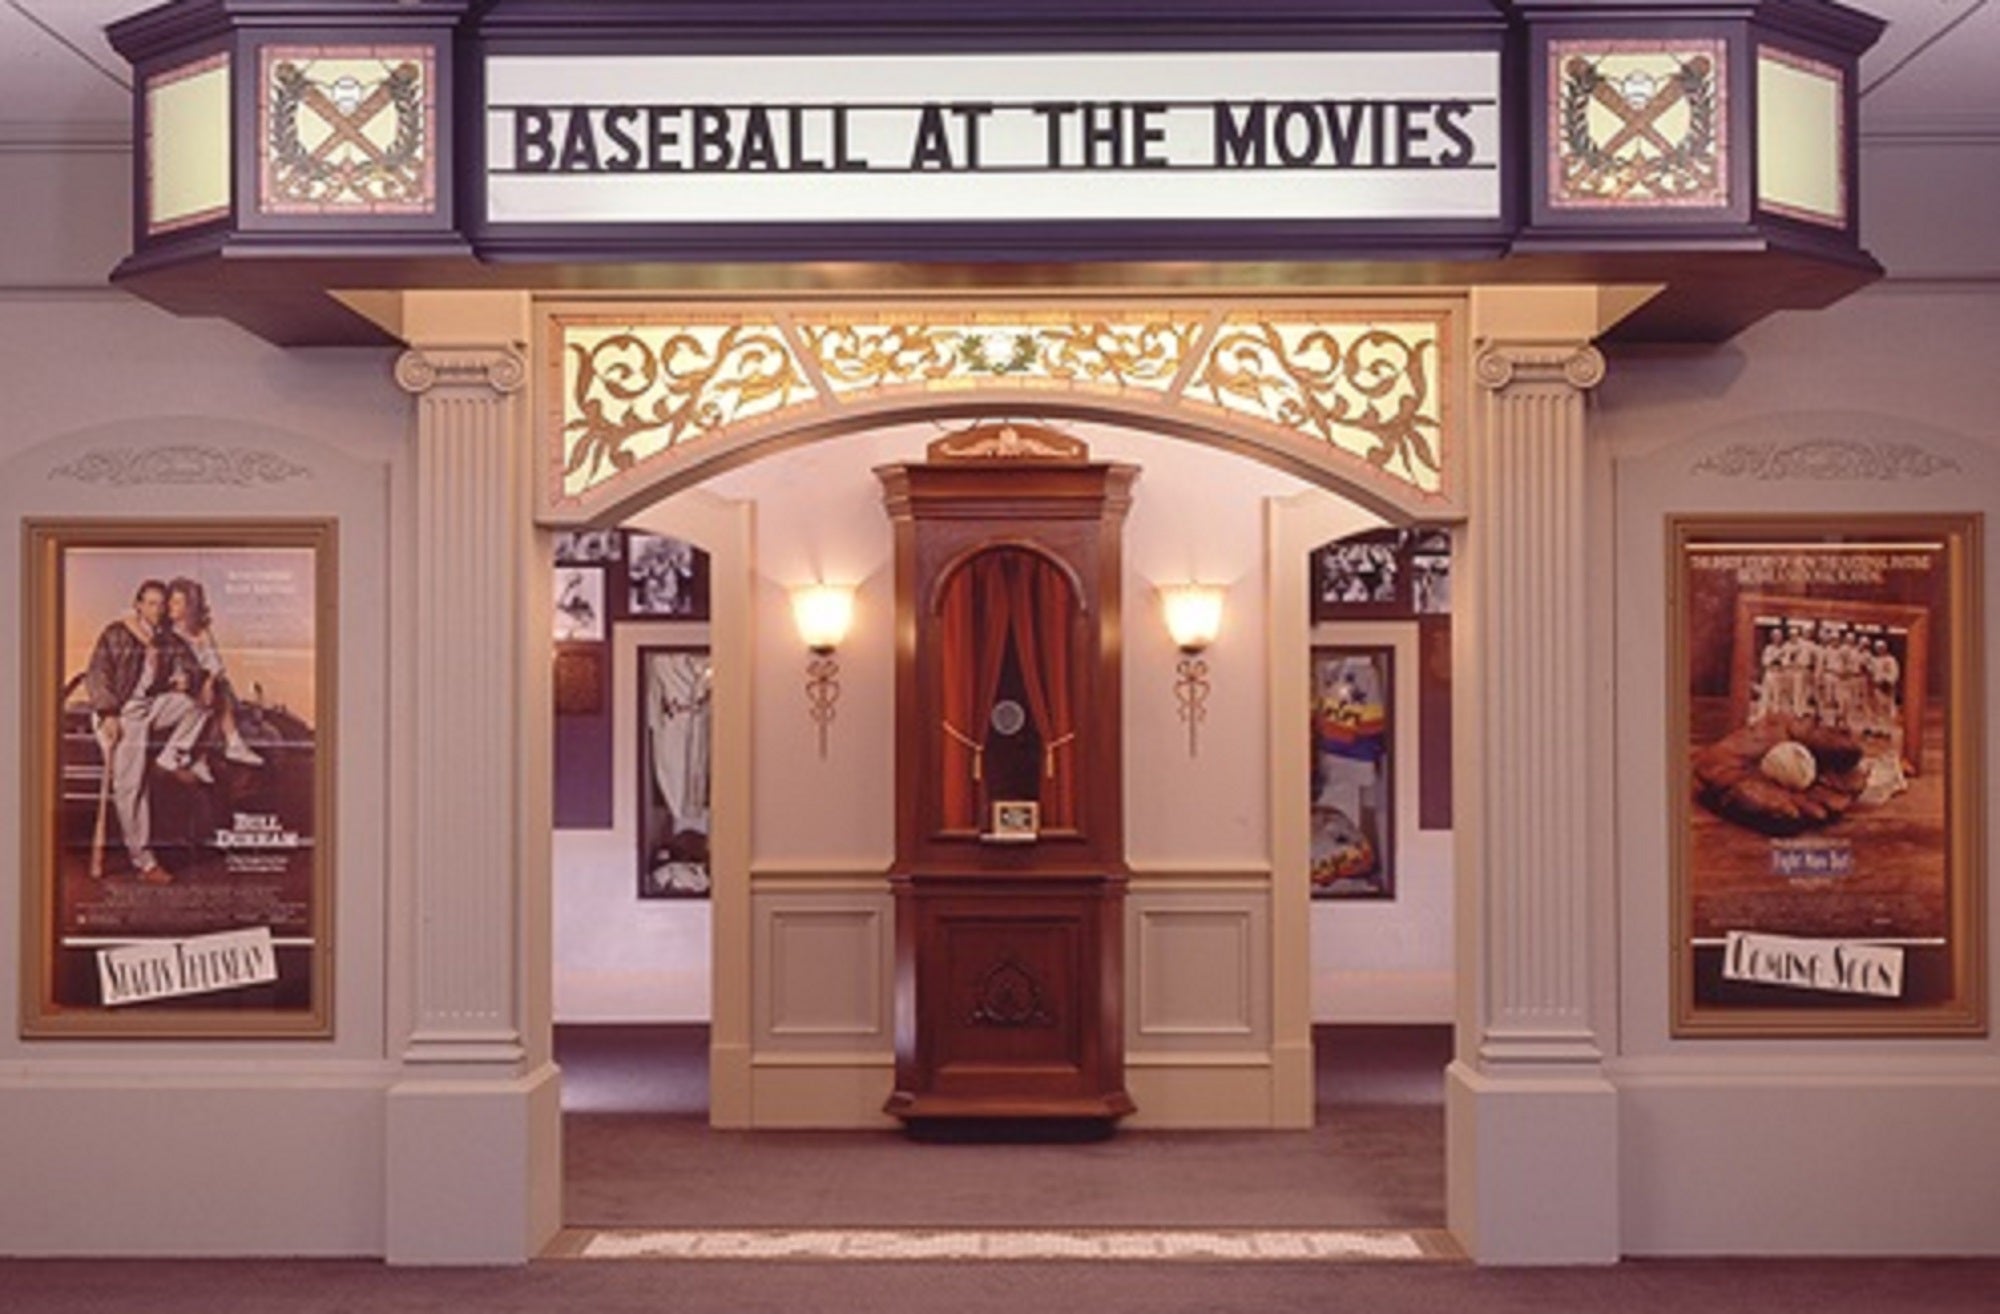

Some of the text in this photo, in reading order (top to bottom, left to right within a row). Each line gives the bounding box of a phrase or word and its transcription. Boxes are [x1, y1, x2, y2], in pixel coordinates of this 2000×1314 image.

[514, 99, 1475, 172] BASEBALL AT THE MOVIES
